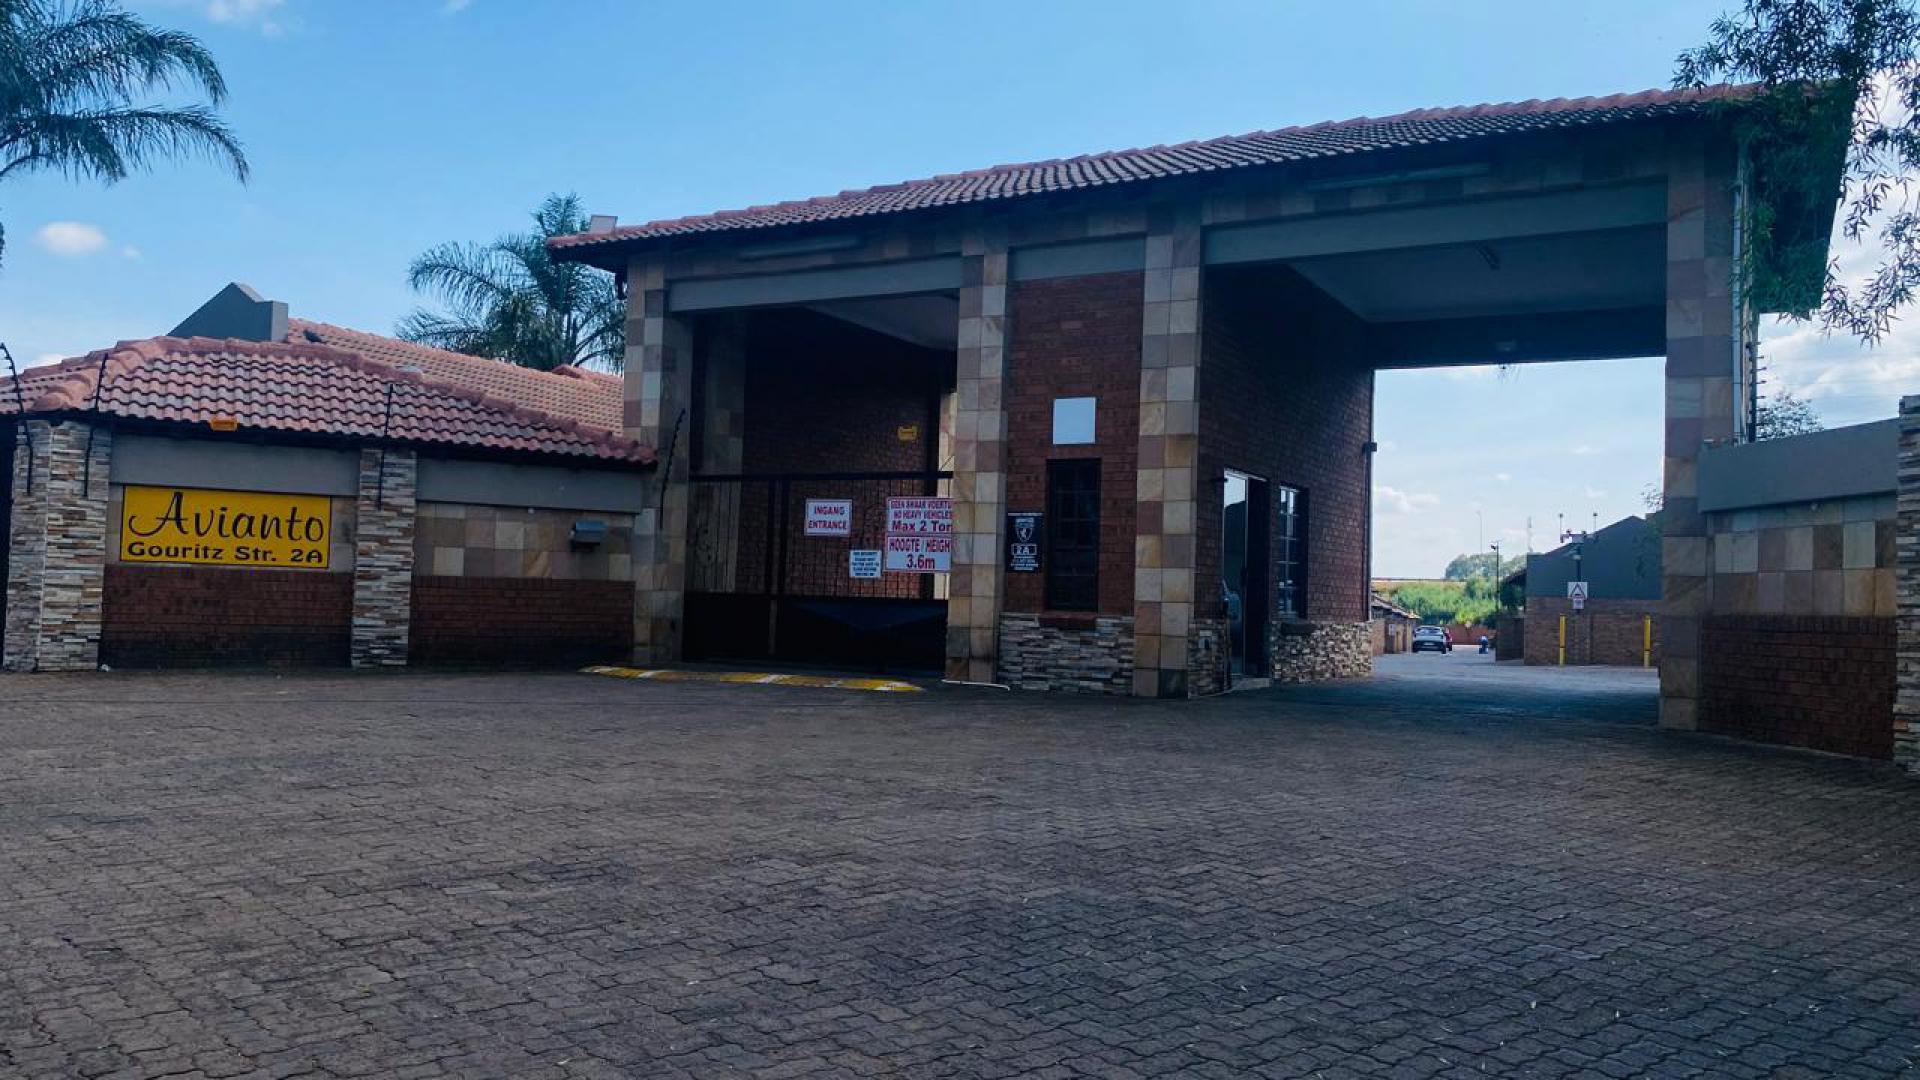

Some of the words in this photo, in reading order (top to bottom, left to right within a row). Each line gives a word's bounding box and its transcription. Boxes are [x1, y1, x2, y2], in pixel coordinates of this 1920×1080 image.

[128, 491, 324, 542] Avianto
[814, 505, 845, 516] INGANG
[808, 520, 847, 530] ENTRANCE
[892, 520, 915, 532] Max
[920, 520, 928, 532] 2
[889, 537, 920, 552] HOOGTE
[926, 538, 950, 552] HEIGH
[127, 542, 225, 560] Gouritz
[234, 546, 277, 562] Str.
[290, 548, 323, 563] 2A
[906, 554, 935, 569] 3.6m
